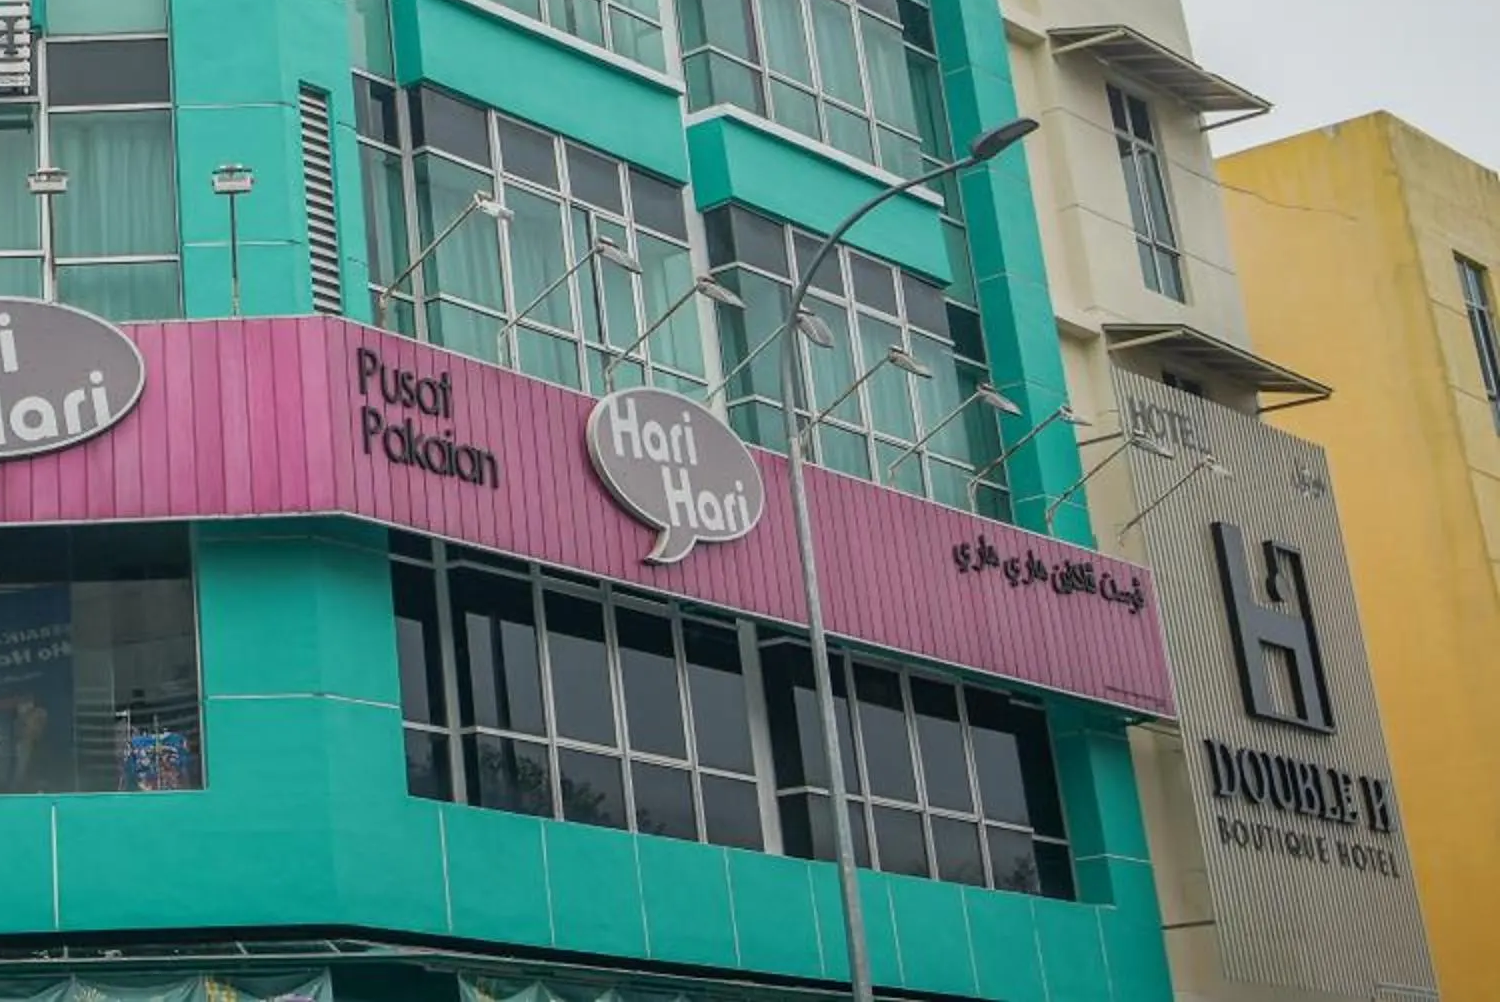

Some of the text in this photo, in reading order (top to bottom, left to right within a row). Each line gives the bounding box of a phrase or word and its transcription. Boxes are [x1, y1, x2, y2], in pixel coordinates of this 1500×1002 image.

[356, 347, 454, 417] Pusat
[361, 410, 499, 490] Pakaian
[609, 398, 698, 467] Hari
[662, 470, 749, 534] Hari
[1205, 739, 1361, 826] DOUBLE
[1218, 816, 1401, 879] BOUTIQUE HOTEL
